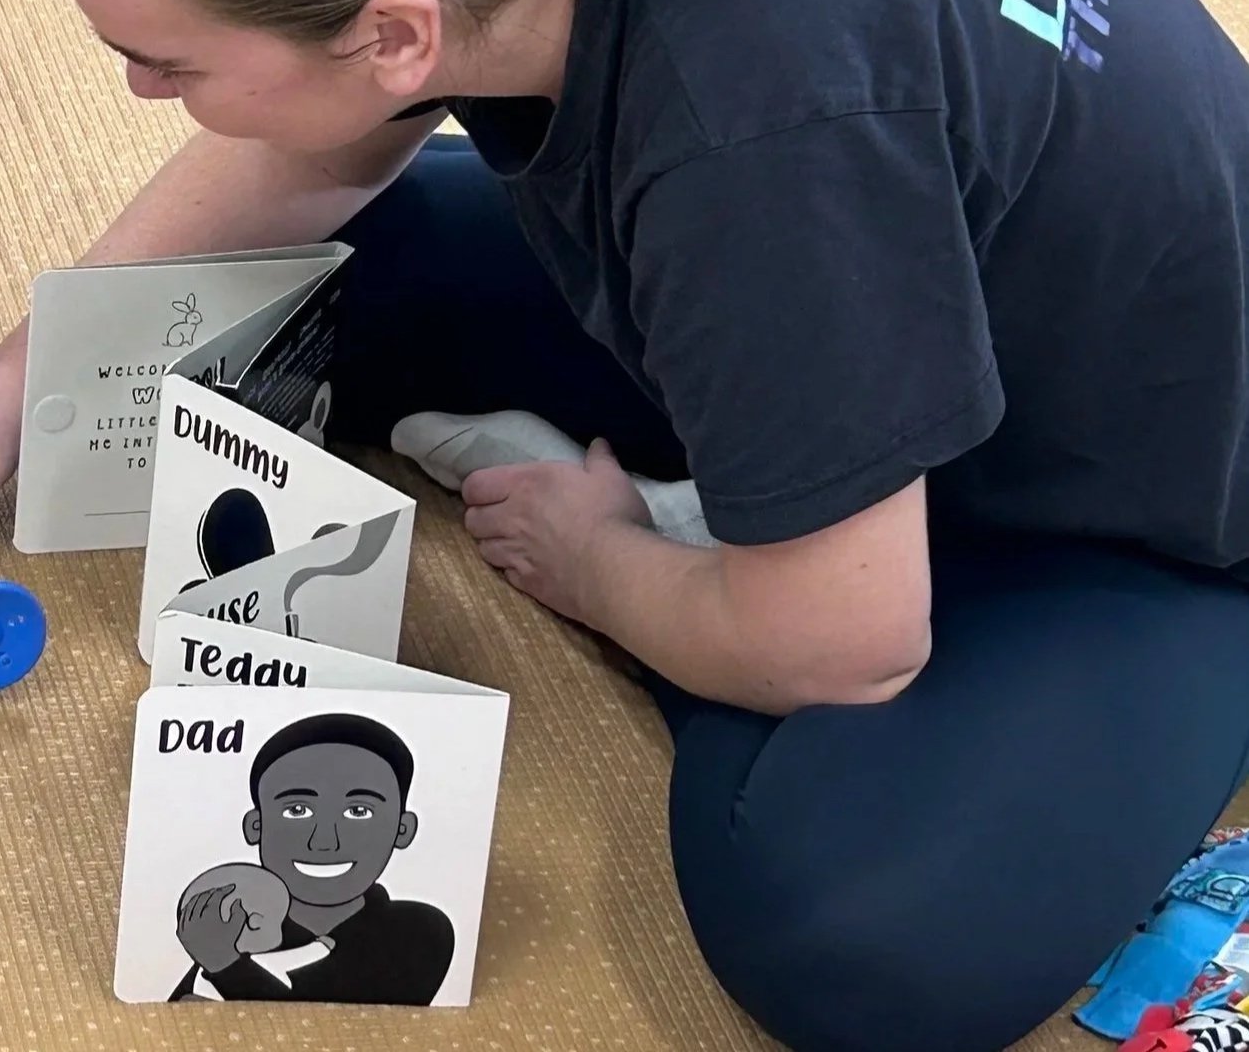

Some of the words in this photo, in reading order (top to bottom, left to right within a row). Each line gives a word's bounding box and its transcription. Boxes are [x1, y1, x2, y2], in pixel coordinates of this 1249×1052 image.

[98, 363, 168, 379] WELCO
[124, 436, 153, 449] INT
[174, 404, 289, 490] Dummy
[127, 456, 147, 469] TO
[197, 590, 260, 625] use
[158, 718, 245, 754] Dad
